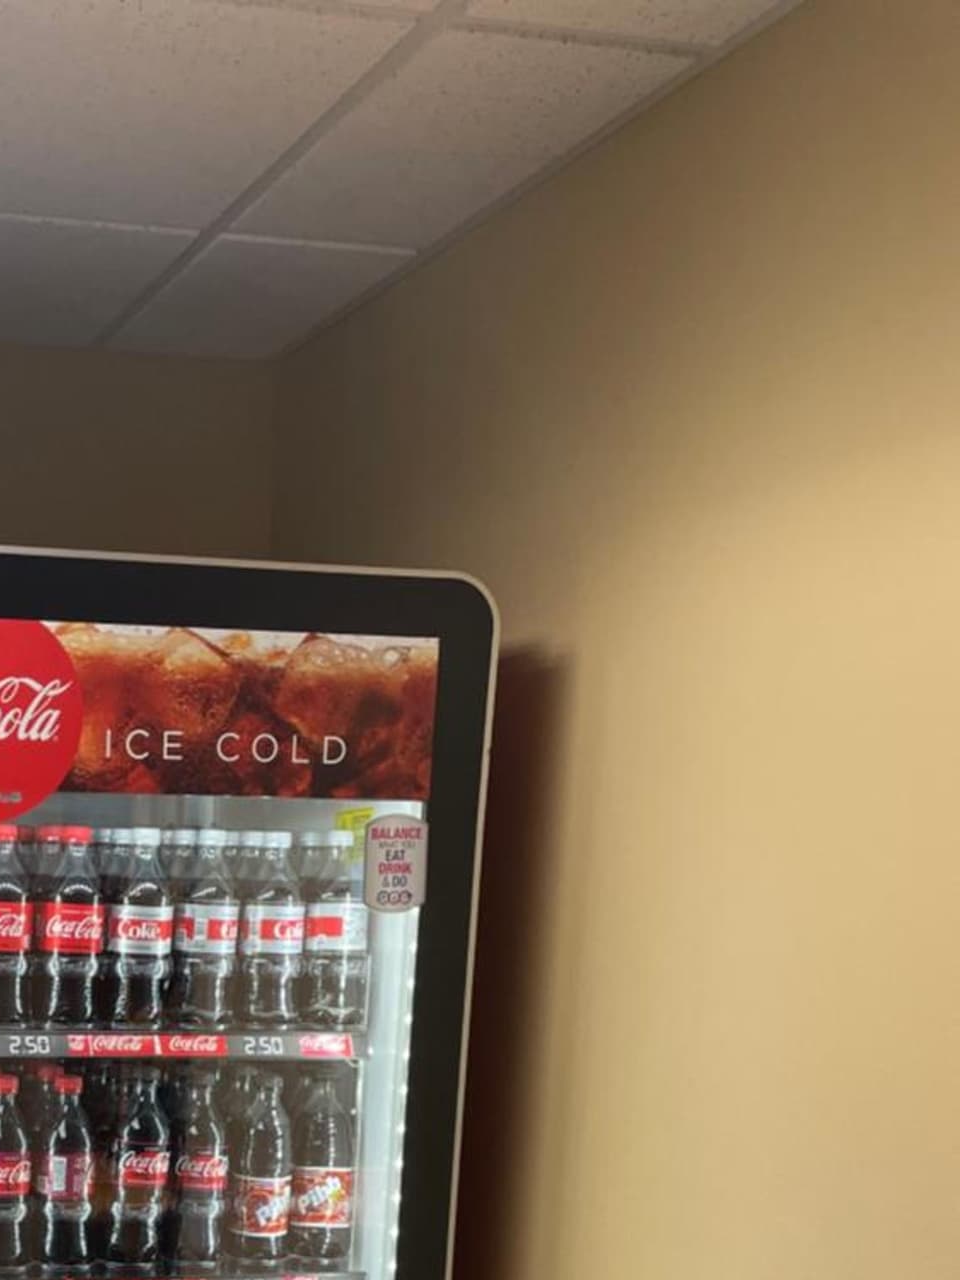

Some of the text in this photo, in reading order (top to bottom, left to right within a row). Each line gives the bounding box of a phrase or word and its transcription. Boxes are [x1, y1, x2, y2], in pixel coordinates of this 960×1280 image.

[105, 729, 347, 764] ICE COLD
[371, 827, 423, 840] BALANCE
[385, 849, 405, 861] EAT
[391, 876, 408, 887] DO
[117, 915, 161, 938] Coke
[274, 917, 305, 939] Cok
[9, 1036, 50, 1054] 2.50
[244, 1037, 283, 1054] 2.50
